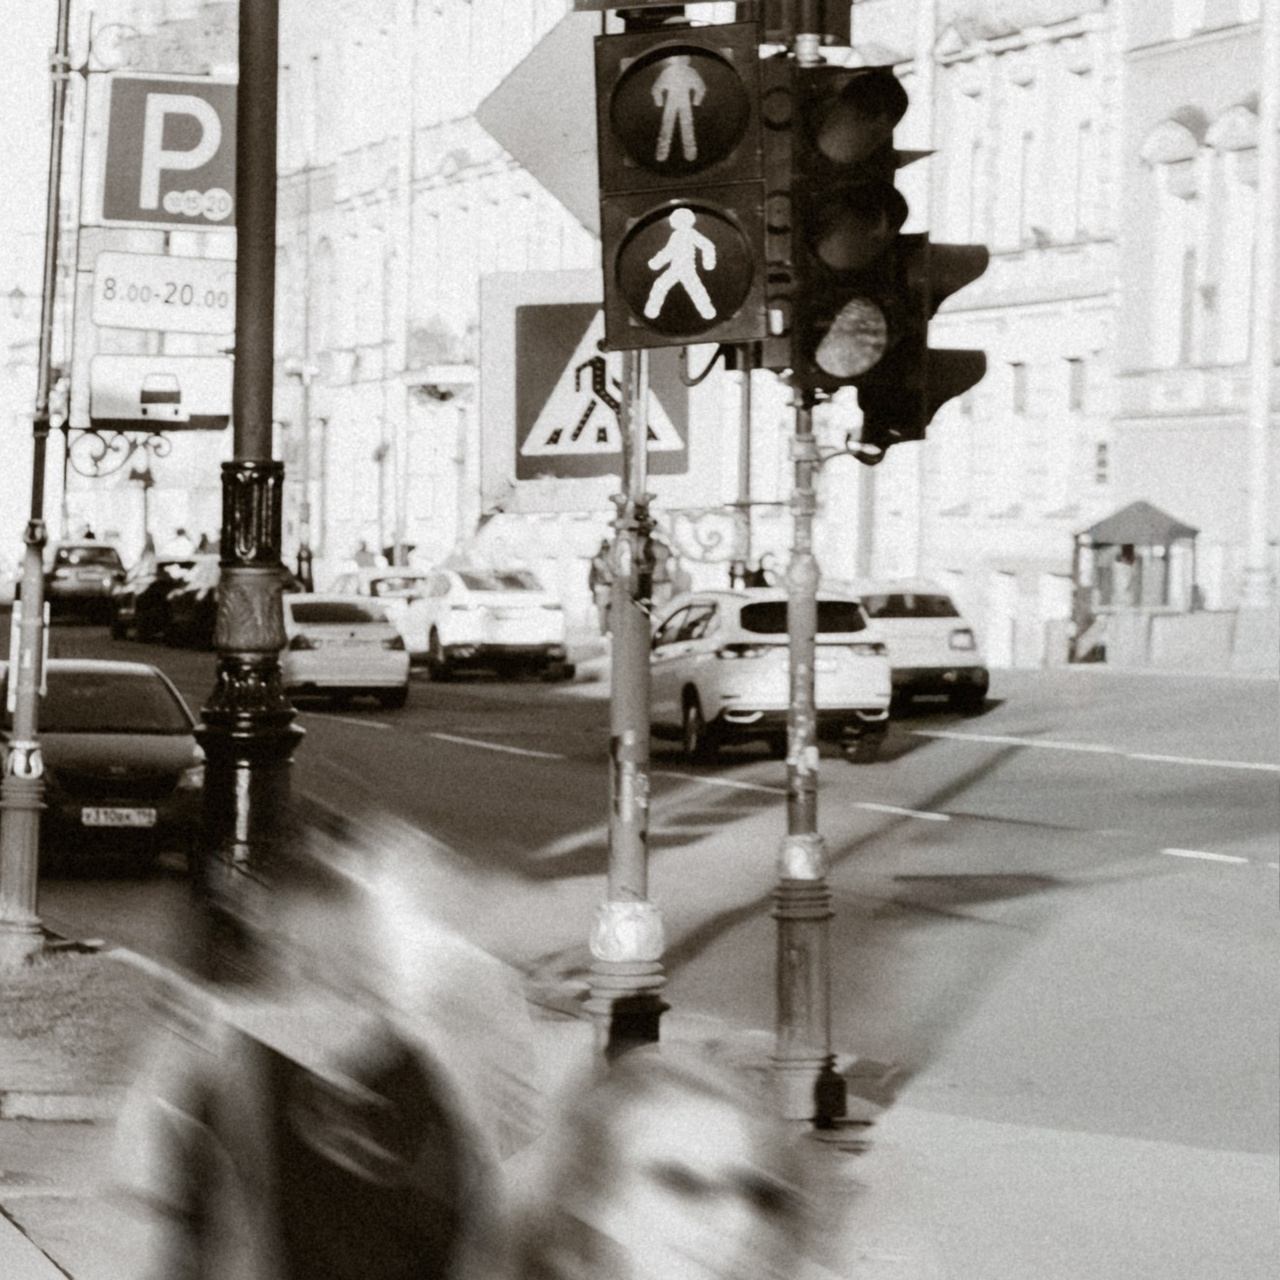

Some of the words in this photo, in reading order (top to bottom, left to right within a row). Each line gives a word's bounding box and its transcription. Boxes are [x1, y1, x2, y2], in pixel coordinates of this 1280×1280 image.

[139, 92, 222, 210] P
[205, 194, 230, 212] 20
[103, 277, 229, 308] 8.00-20.00
